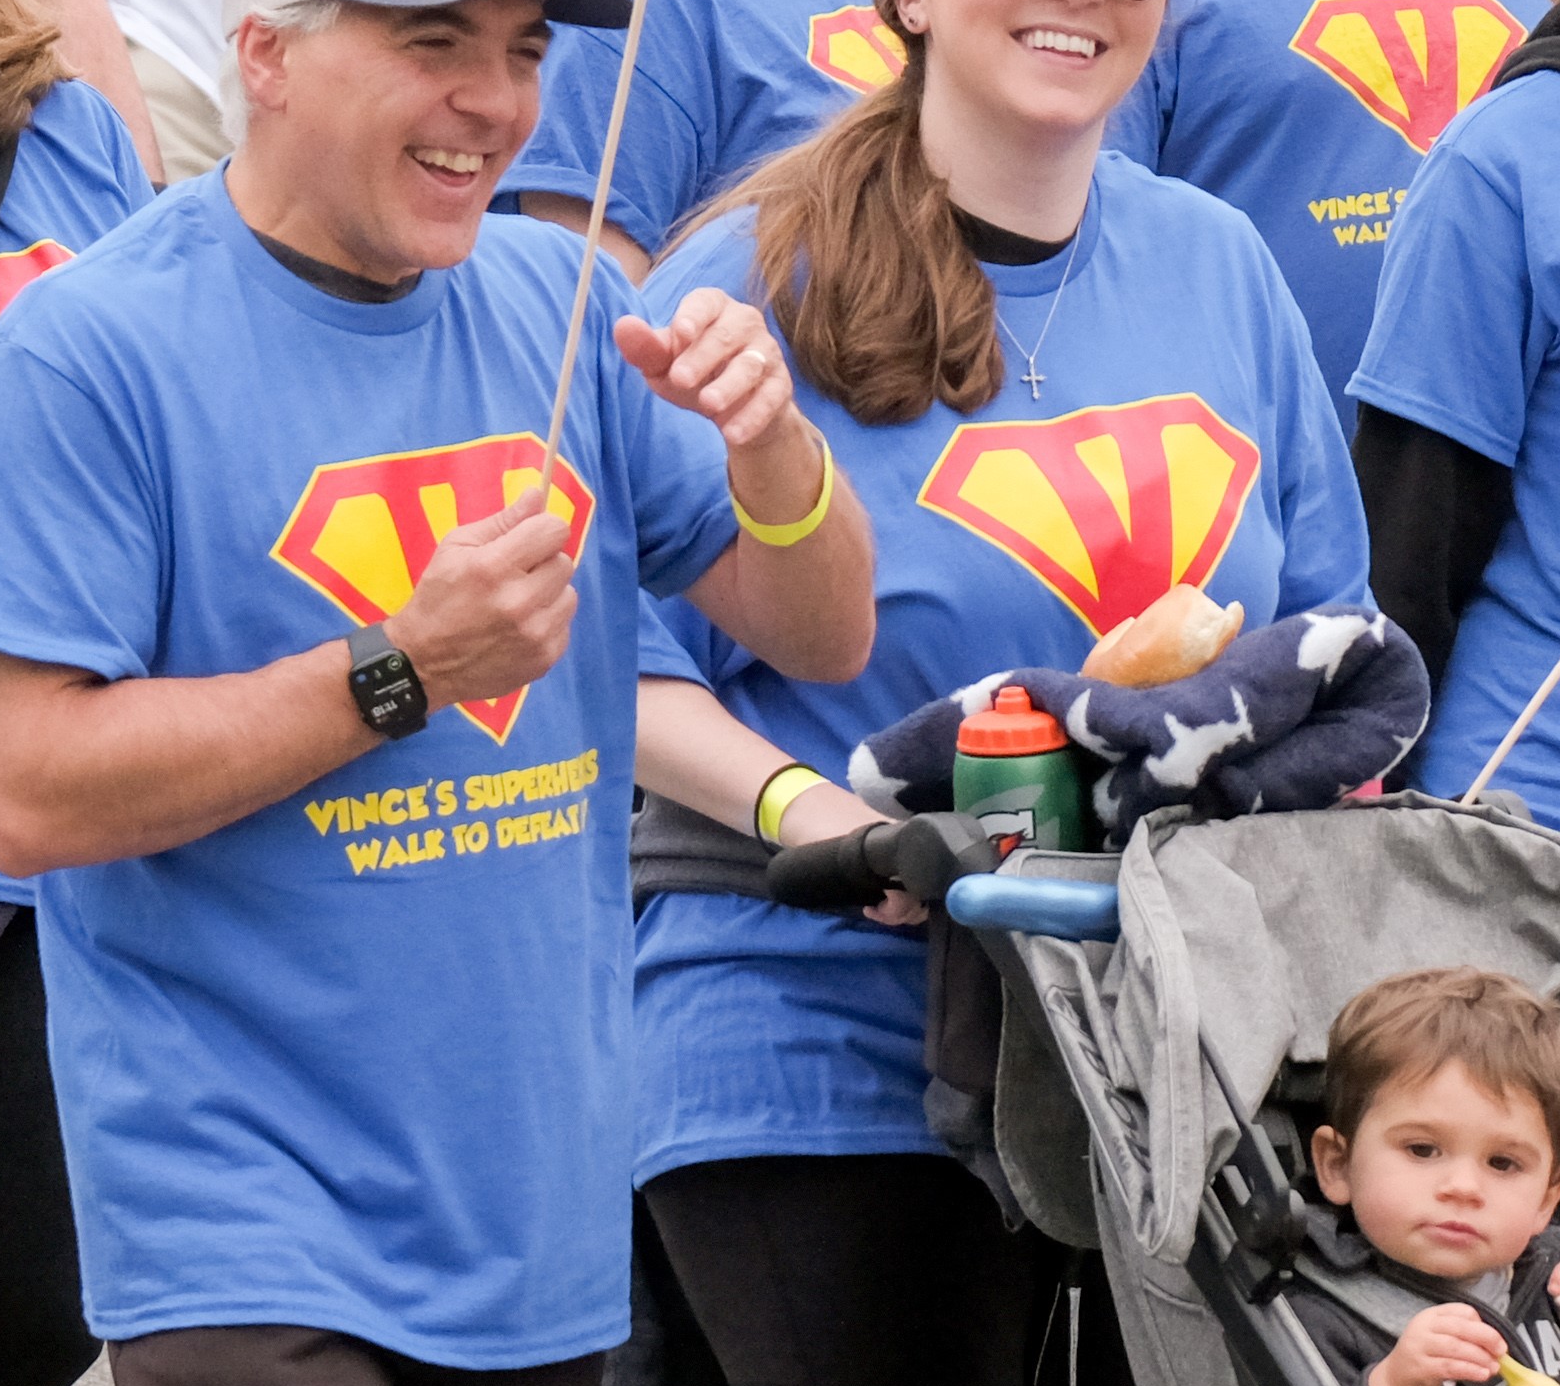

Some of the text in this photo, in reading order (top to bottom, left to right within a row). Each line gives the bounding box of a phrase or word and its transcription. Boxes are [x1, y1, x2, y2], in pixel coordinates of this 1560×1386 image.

[304, 777, 458, 836] VINCE'S
[345, 828, 445, 876] WALK
[452, 821, 489, 854] TO
